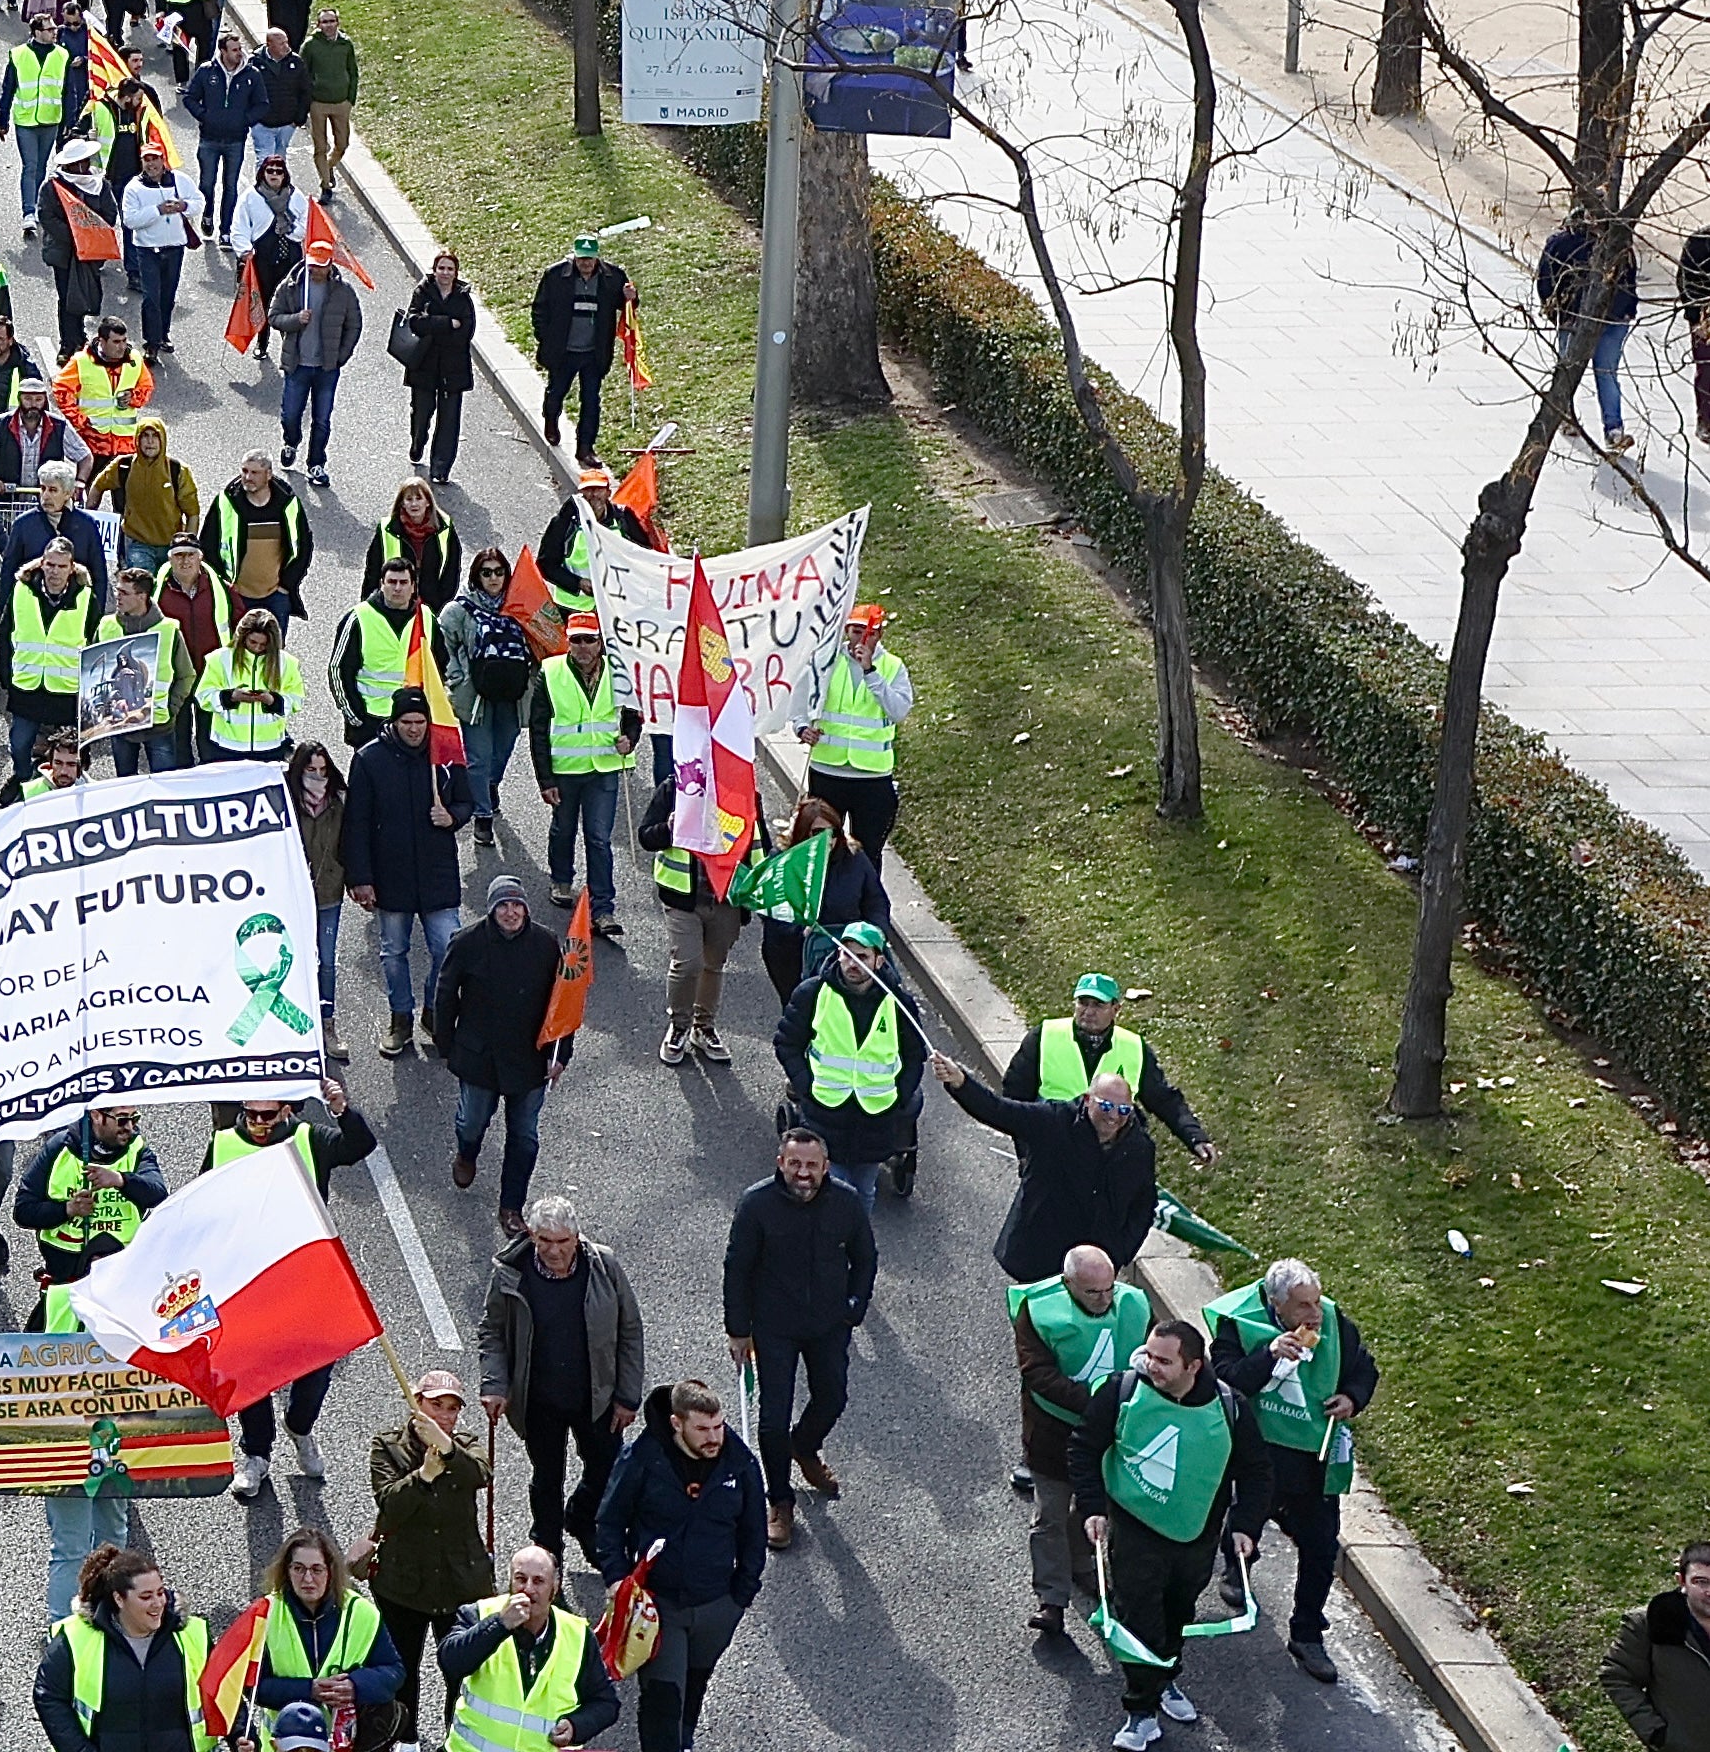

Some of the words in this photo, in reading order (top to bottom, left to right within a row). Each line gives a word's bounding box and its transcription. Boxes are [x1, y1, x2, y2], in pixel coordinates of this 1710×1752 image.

[676, 107, 729, 118] MADRID
[725, 610, 802, 649] TU
[75, 869, 267, 925] FUTURO.
[43, 962, 77, 988] DE
[82, 948, 110, 973] LA
[75, 982, 211, 1018] AGRÍCOLA
[47, 1052, 63, 1071] A
[68, 1027, 203, 1061] NUESTROS
[118, 1066, 141, 1088] Y
[18, 1374, 62, 1394] MUY
[68, 1370, 121, 1391] FÁCIL
[25, 1398, 65, 1417] ARA
[70, 1395, 115, 1416] CON
[120, 1392, 151, 1411] UN
